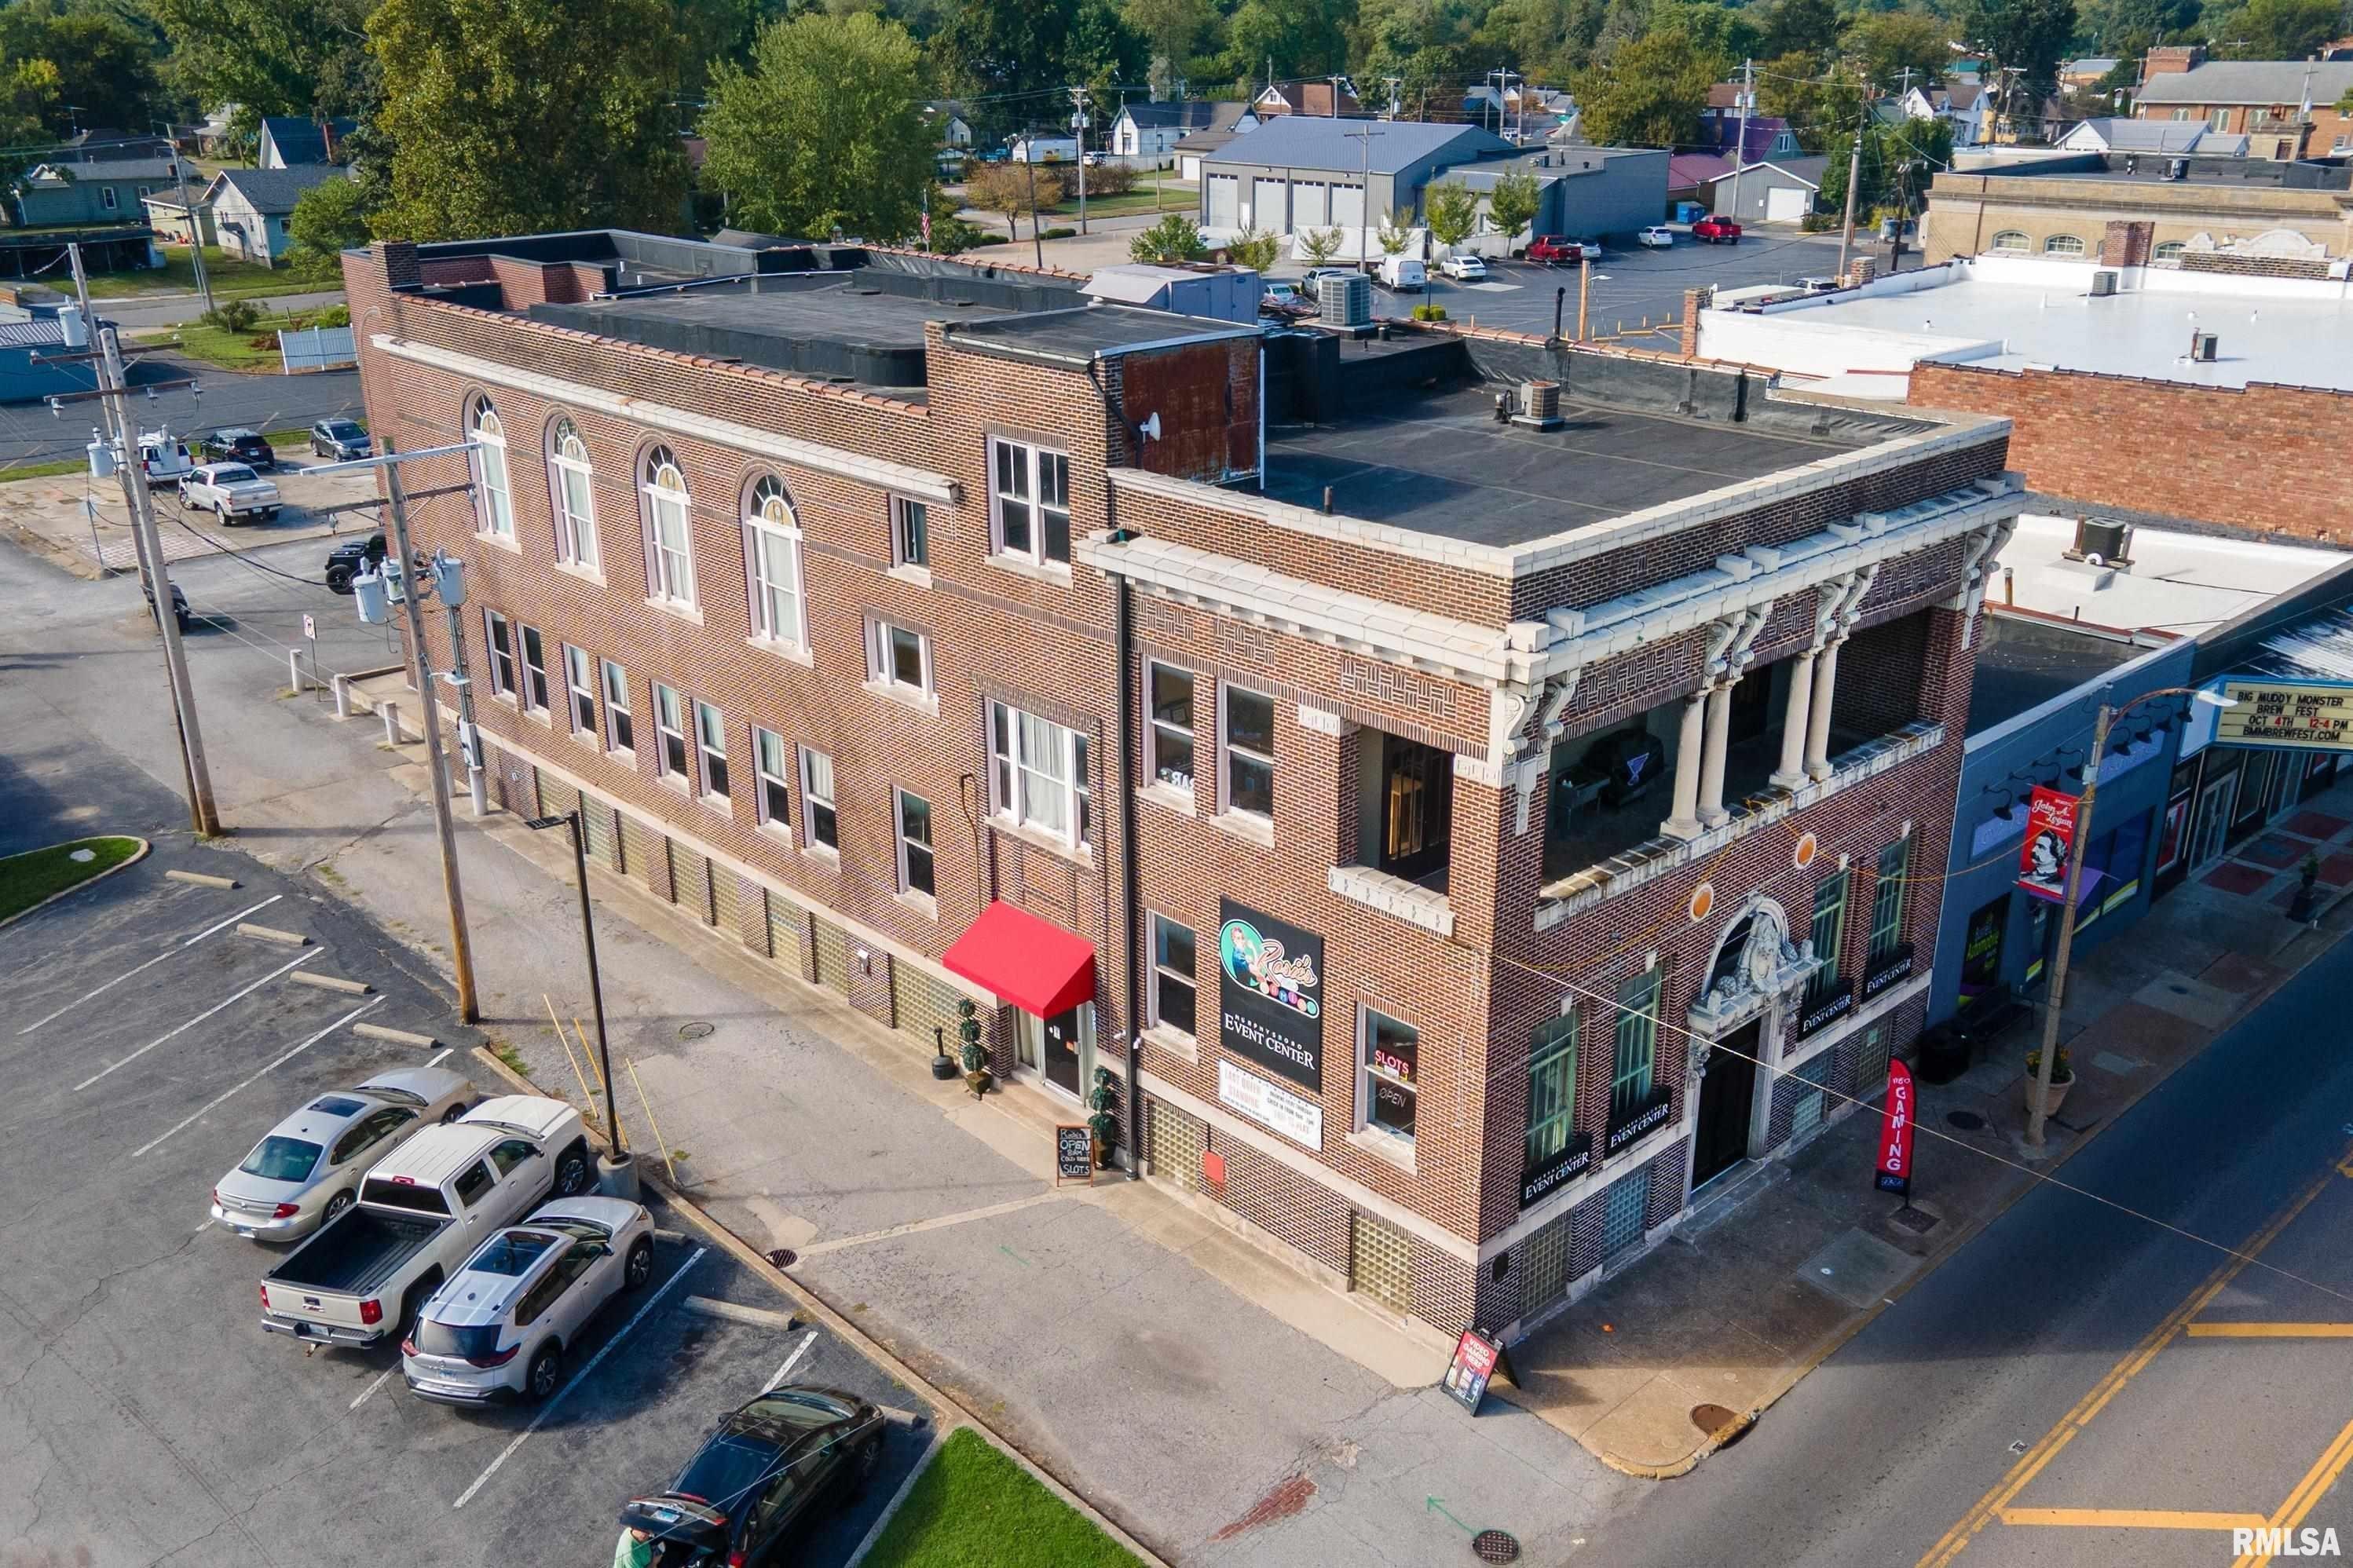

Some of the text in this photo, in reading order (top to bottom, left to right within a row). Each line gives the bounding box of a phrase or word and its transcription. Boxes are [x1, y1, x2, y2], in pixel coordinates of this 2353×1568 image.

[2238, 692, 2344, 707] BIG MUDDY MONSTER
[2256, 704, 2319, 716] BREW FEST
[2249, 715, 2348, 729] OCT 4TH 12-4 PM
[2243, 726, 2340, 741] BMMBREWFEST.COM
[2032, 799, 2055, 813] John
[2047, 812, 2073, 828] Logan
[1224, 1013, 1316, 1070] EVENT CENTER
[1375, 1050, 1410, 1074] SLOTS
[1379, 1087, 1407, 1108] OPEN
[1610, 1124, 1638, 1148] EVENT
[1638, 1104, 1668, 1131] CENTER
[1886, 1087, 1906, 1171] GAMING
[1060, 1139, 1091, 1150] OPEN
[1063, 1164, 1090, 1174] SLOTS
[1526, 1174, 1555, 1200] EVENT
[1556, 1152, 1590, 1180] CENTER
[1469, 1338, 1489, 1357] VIDEO
